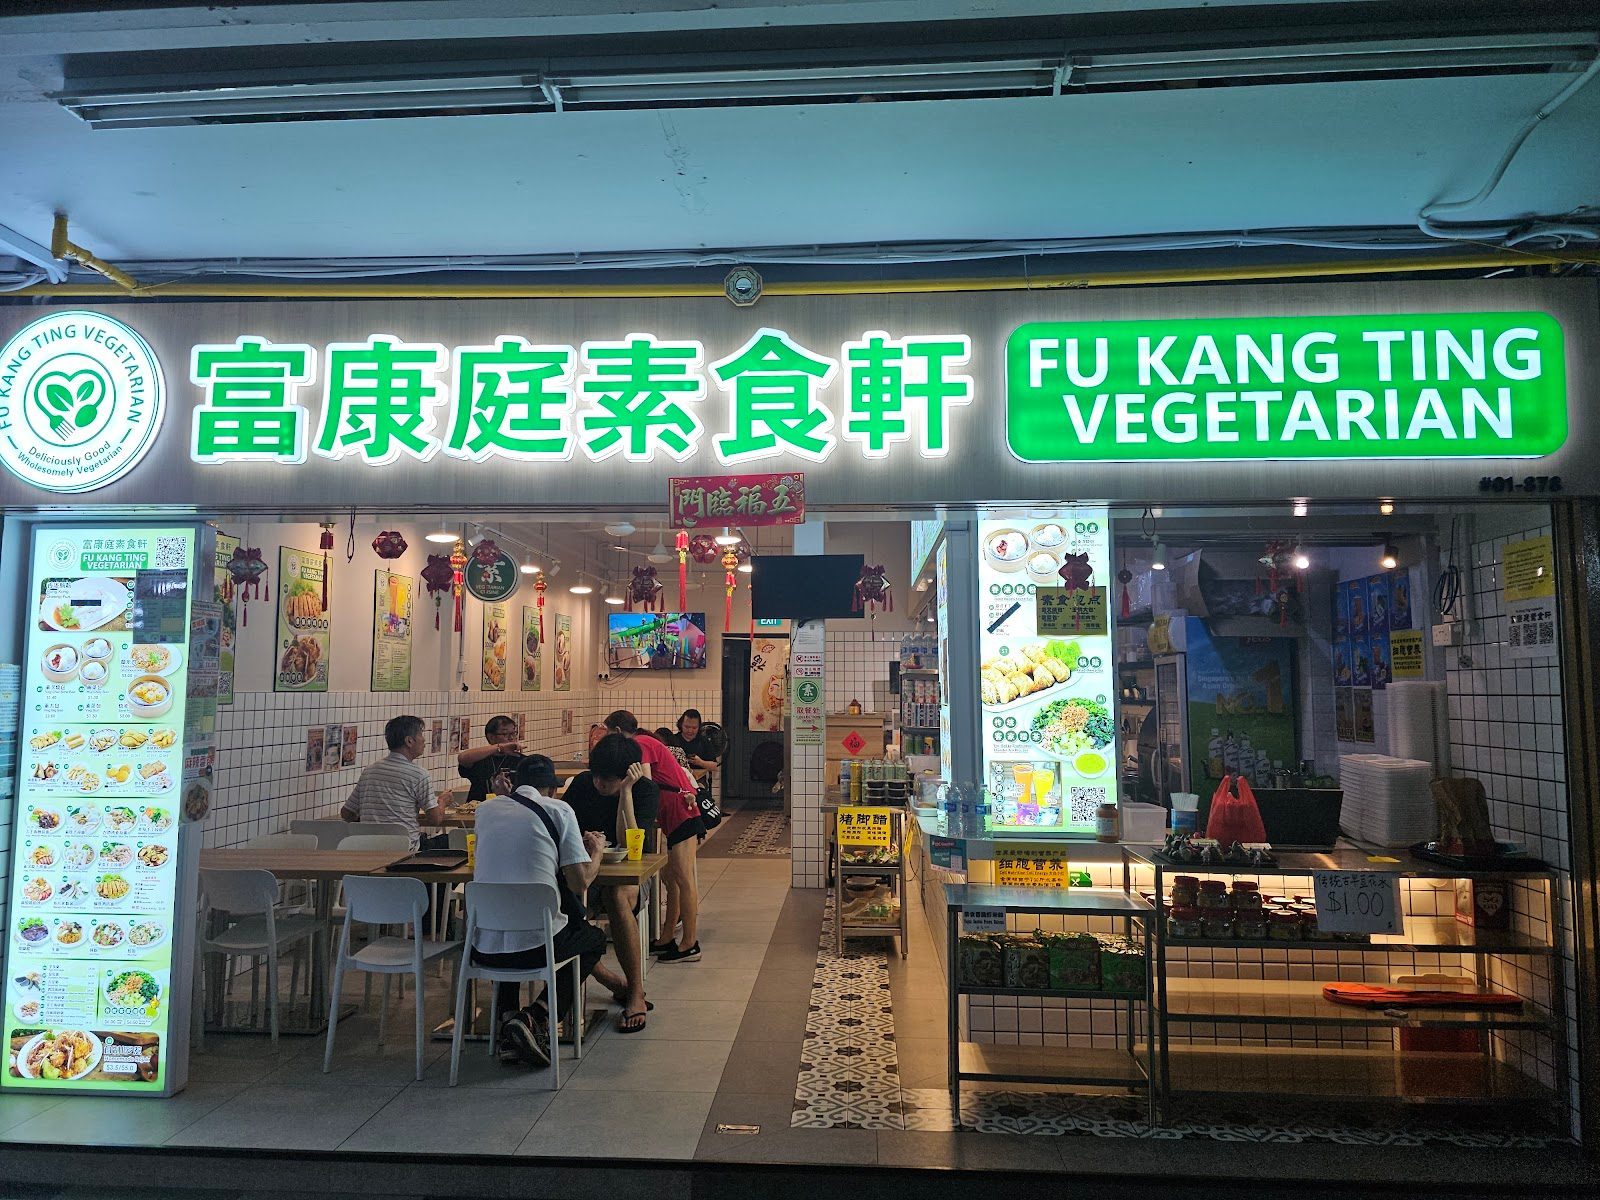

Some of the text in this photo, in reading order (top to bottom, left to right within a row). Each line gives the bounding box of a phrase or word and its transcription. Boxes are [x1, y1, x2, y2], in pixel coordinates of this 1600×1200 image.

[1029, 327, 1542, 388] FU KANG TING
[0, 325, 145, 430] FU KANG TING VEGETARIAN
[197, 333, 968, 458] 富康庭素食軒
[1062, 387, 1513, 444] VEGETARIAN
[17, 446, 123, 478] Wholesomely Vegetarian
[28, 441, 112, 466] Deliciously Good
[82, 538, 149, 550] 富康庭素食軒
[83, 553, 147, 562] FU KANG TING
[87, 561, 142, 570] VEGETARIAN
[839, 813, 888, 826] 猪脚醋
[998, 858, 1064, 871] 细胞营养
[1324, 891, 1385, 918] $1.00
